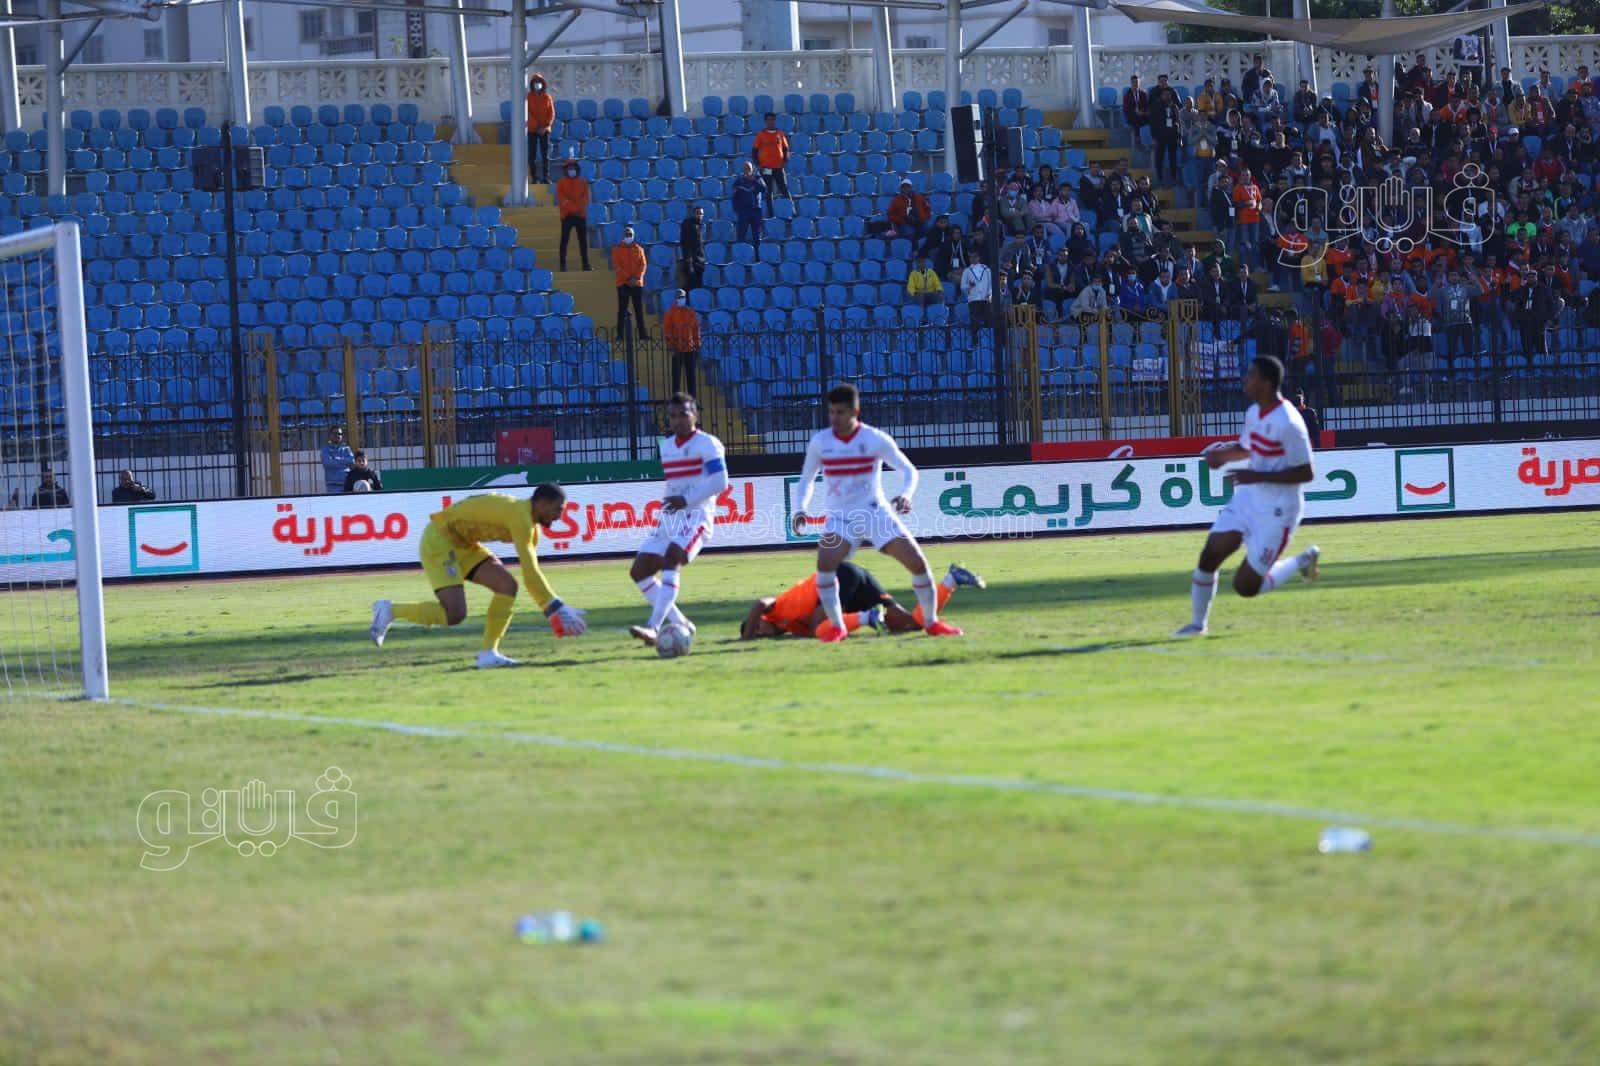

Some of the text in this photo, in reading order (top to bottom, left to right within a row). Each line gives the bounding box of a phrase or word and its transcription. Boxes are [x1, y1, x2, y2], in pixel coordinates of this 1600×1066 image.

[938, 463, 1142, 528] كريمة
[1517, 446, 1600, 496] صرية
[541, 499, 664, 549] مصري
[713, 482, 754, 525] لك
[272, 503, 410, 556] مصرية
